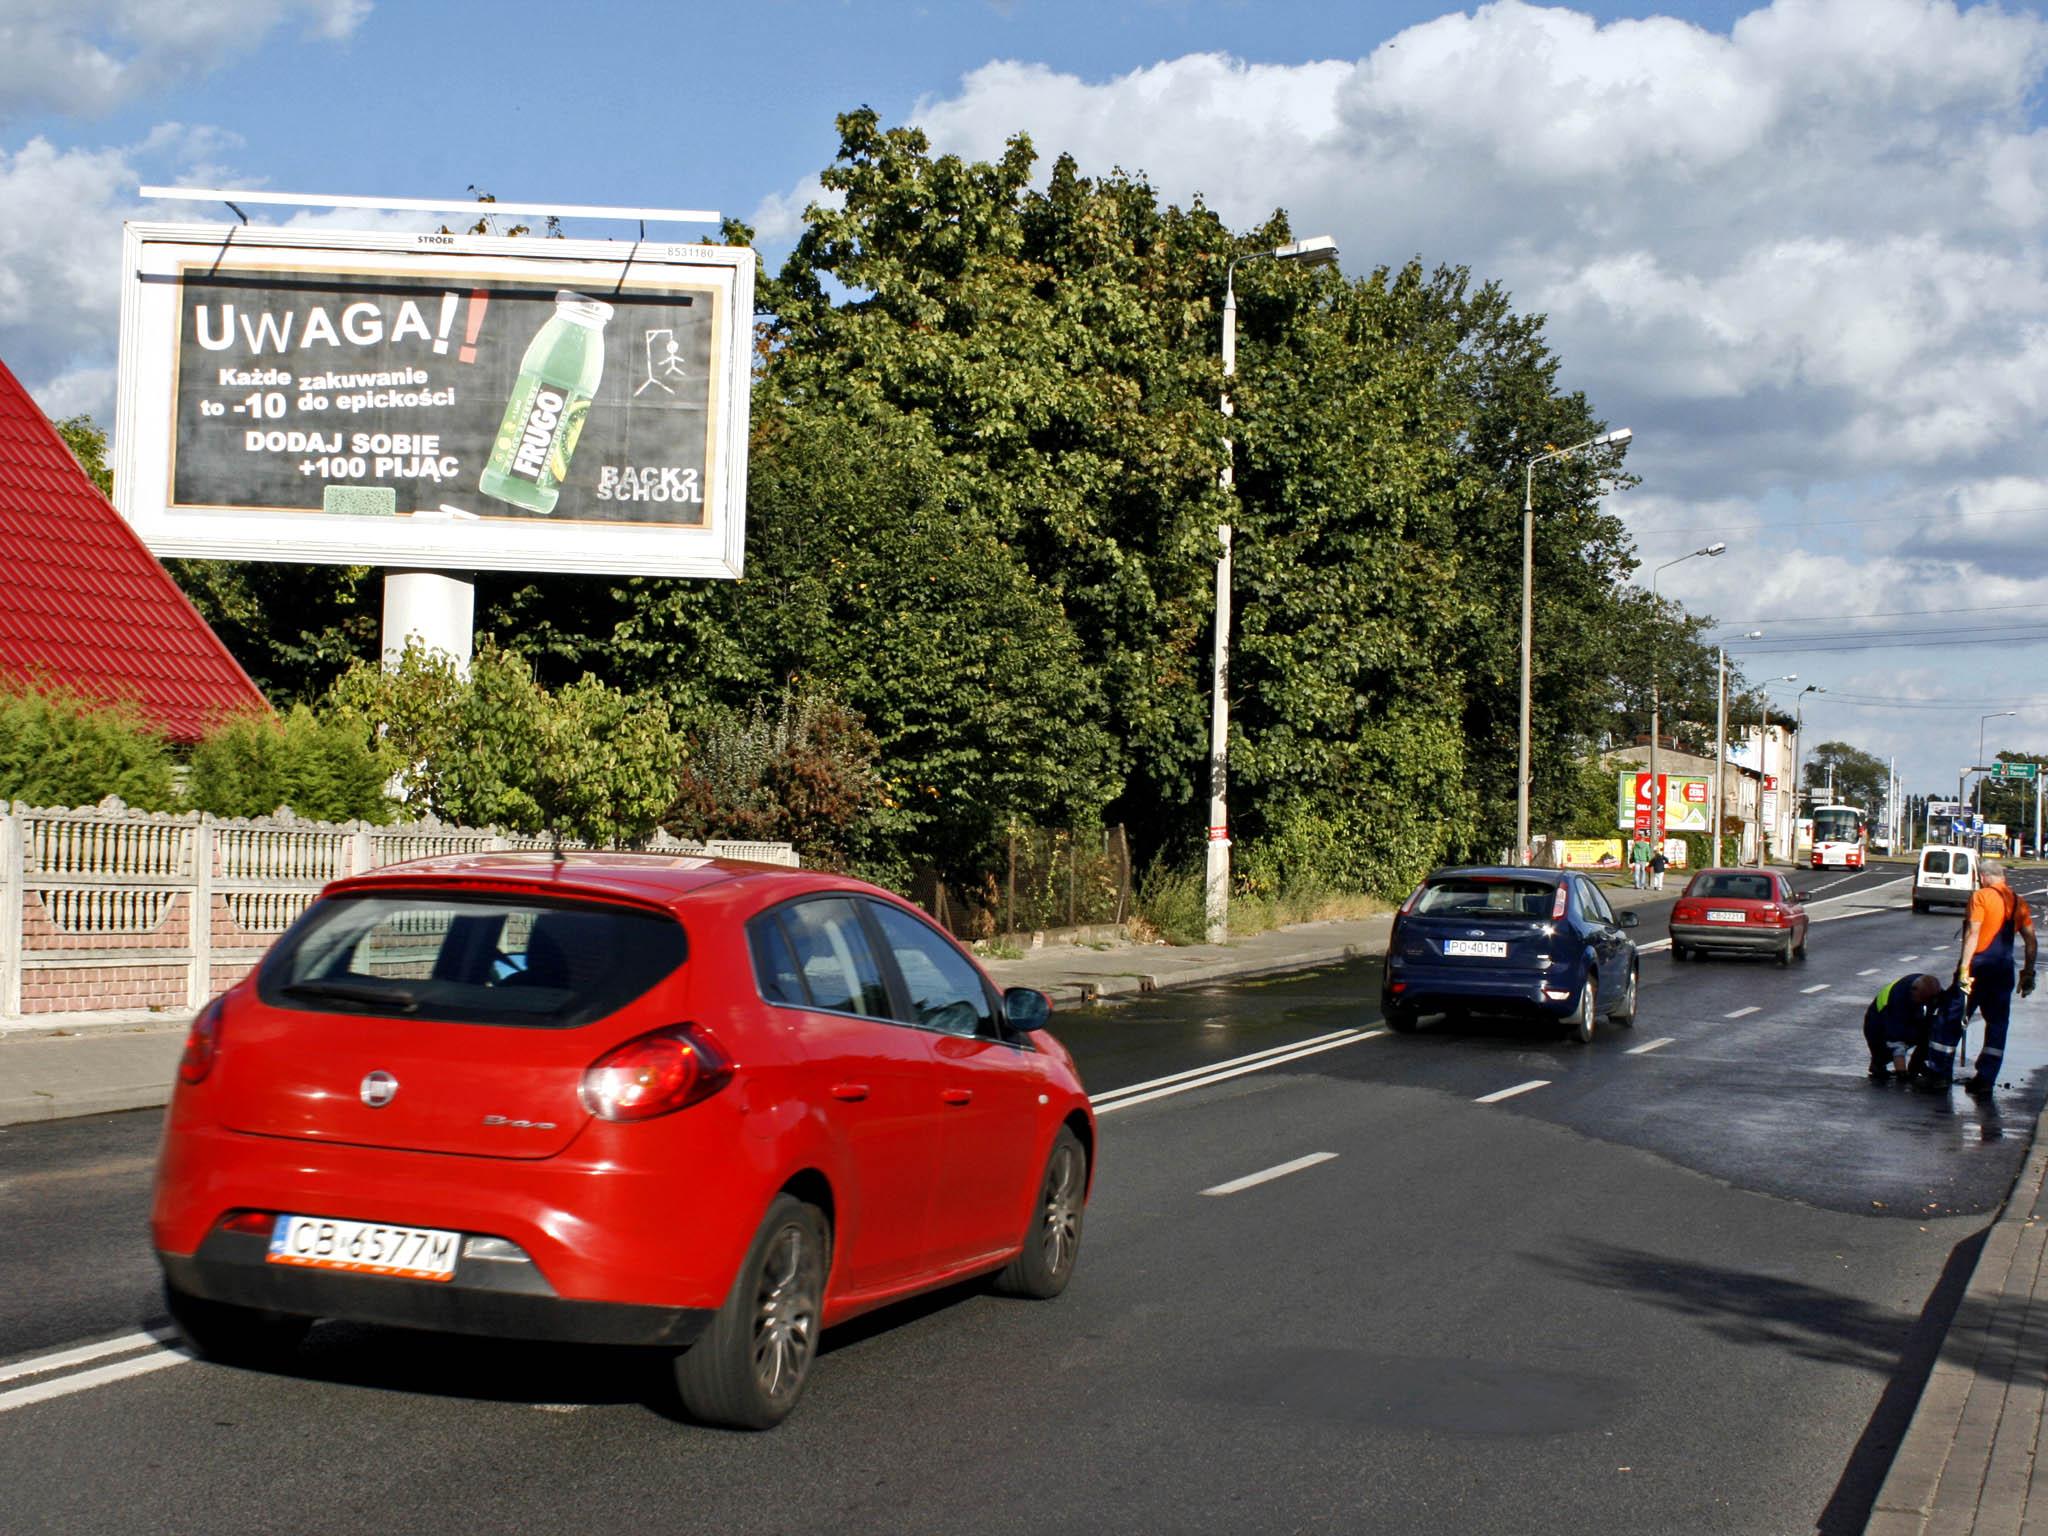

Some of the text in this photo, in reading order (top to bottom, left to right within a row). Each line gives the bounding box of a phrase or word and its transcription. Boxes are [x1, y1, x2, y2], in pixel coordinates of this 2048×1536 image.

[667, 246, 714, 258] 8531180
[219, 367, 428, 391] Każde zakuwanie
[200, 387, 455, 418] to -10 do epickości
[245, 431, 440, 455] DODAJ SOBIE
[512, 389, 564, 478] FRUGO
[298, 456, 459, 482] +100 PIJĄC
[597, 482, 704, 503] SCHOOL
